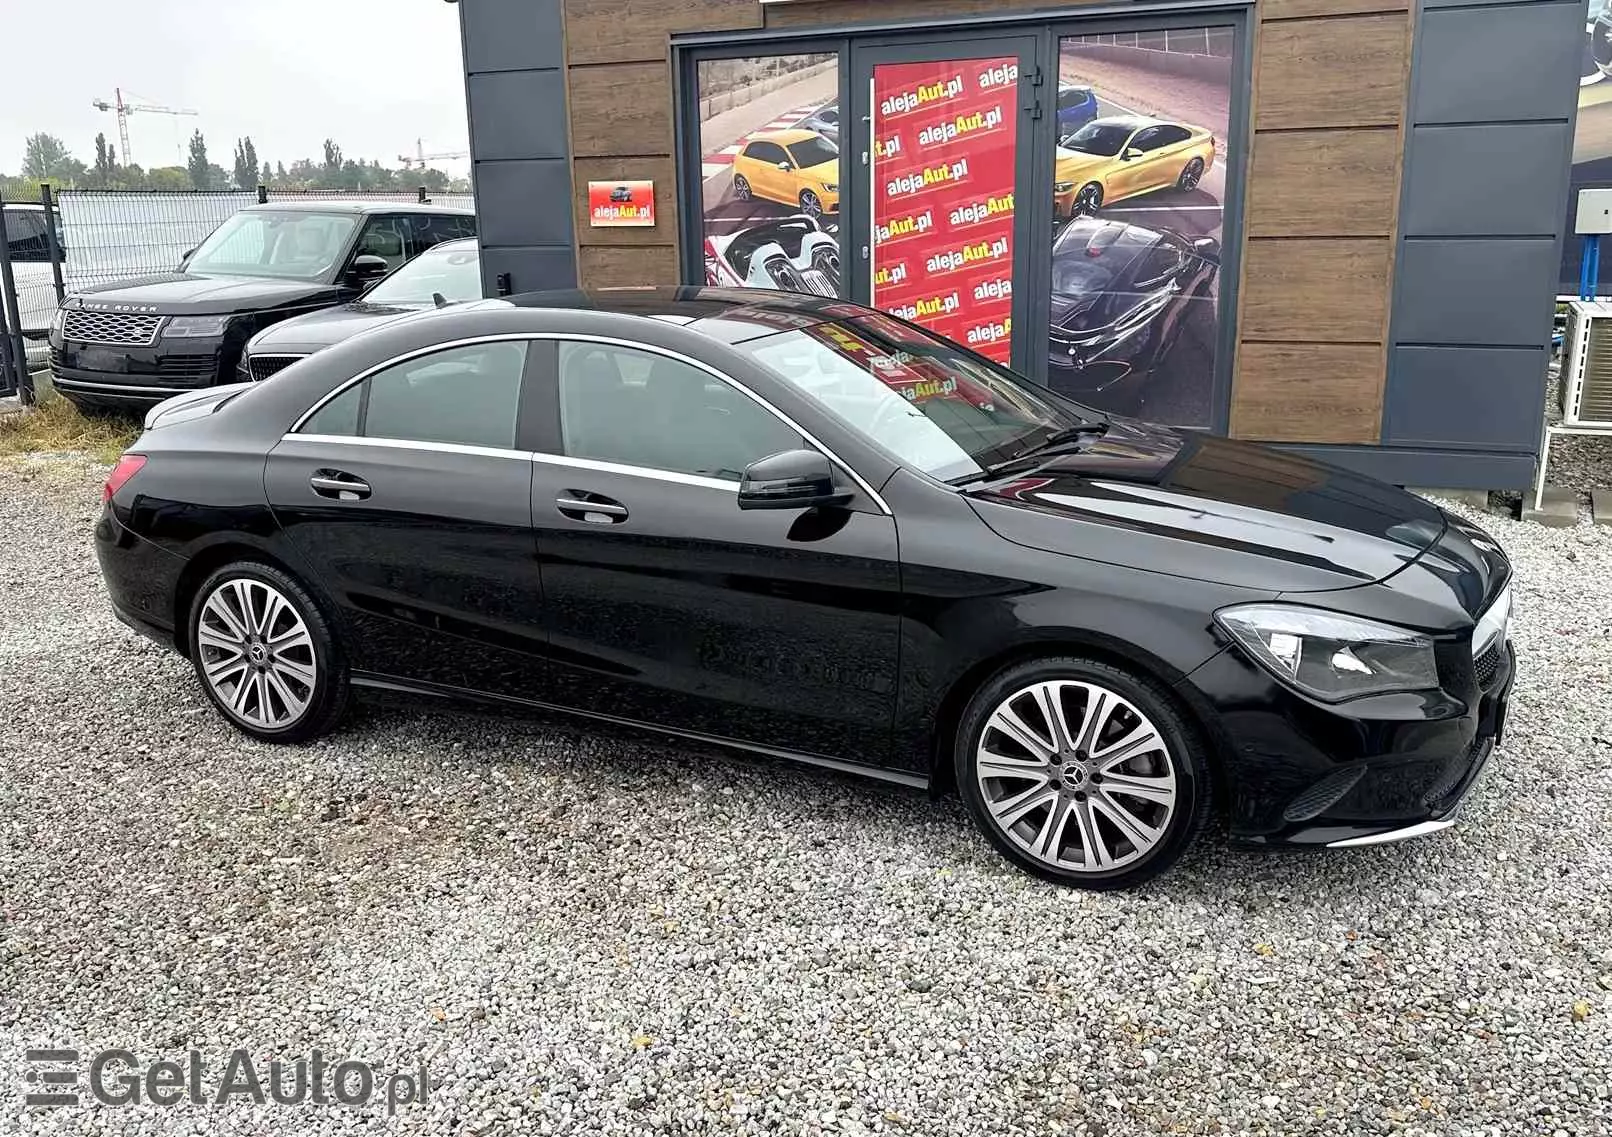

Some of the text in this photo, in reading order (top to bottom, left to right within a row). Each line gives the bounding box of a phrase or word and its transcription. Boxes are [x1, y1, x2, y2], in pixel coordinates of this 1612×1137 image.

[881, 76, 963, 115] alejaAut.pl
[919, 106, 1001, 145] alejaAut.pl
[875, 135, 901, 157] t.pl
[887, 159, 968, 196] alejaAut.pl
[594, 205, 651, 221] alejaAut.pl
[926, 237, 1008, 272] alejaAut.pl
